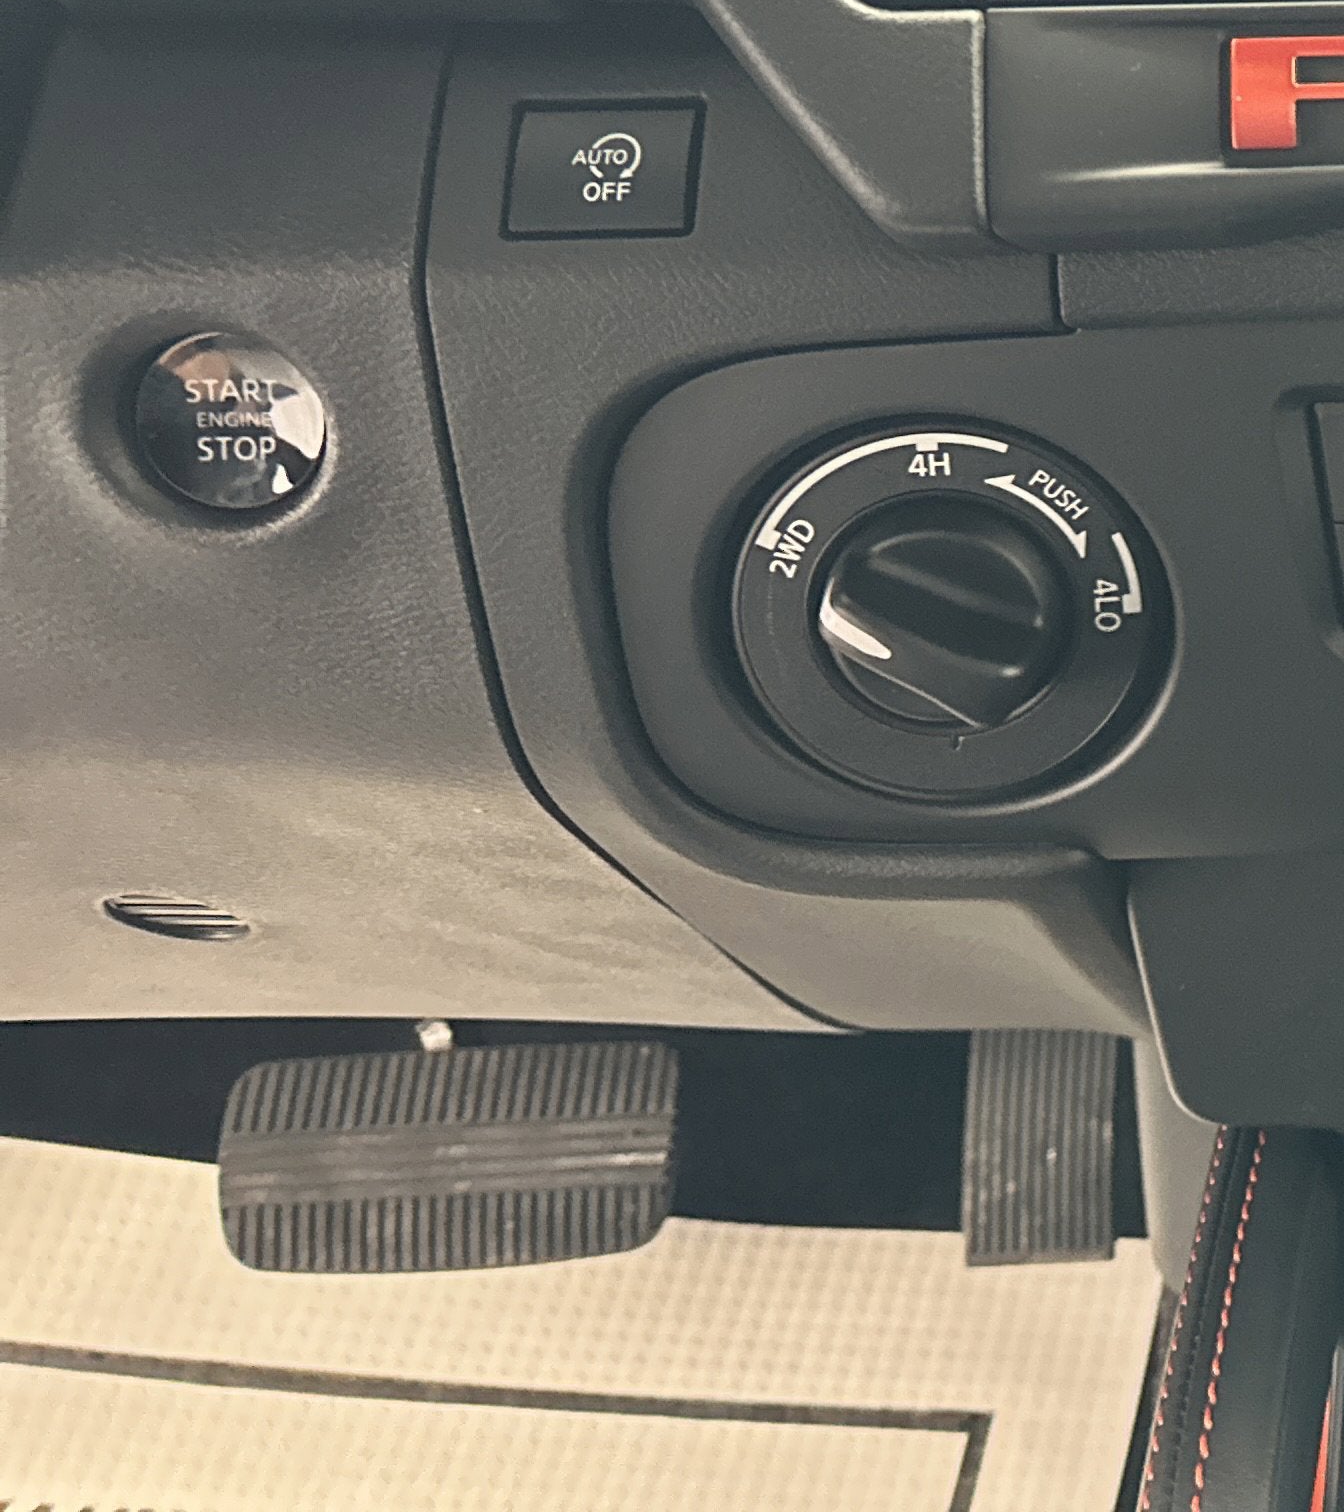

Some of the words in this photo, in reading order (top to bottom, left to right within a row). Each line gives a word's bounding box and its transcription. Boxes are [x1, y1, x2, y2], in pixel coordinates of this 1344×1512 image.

[571, 147, 629, 167] AUTO
[582, 181, 632, 202] OFF
[183, 378, 278, 404] START
[195, 410, 274, 429] ENGINE
[196, 434, 277, 462] STOP
[908, 453, 951, 477] 4H
[1027, 469, 1090, 521] PUSH
[769, 518, 815, 579] 2WD
[1093, 577, 1121, 633] 4LO
